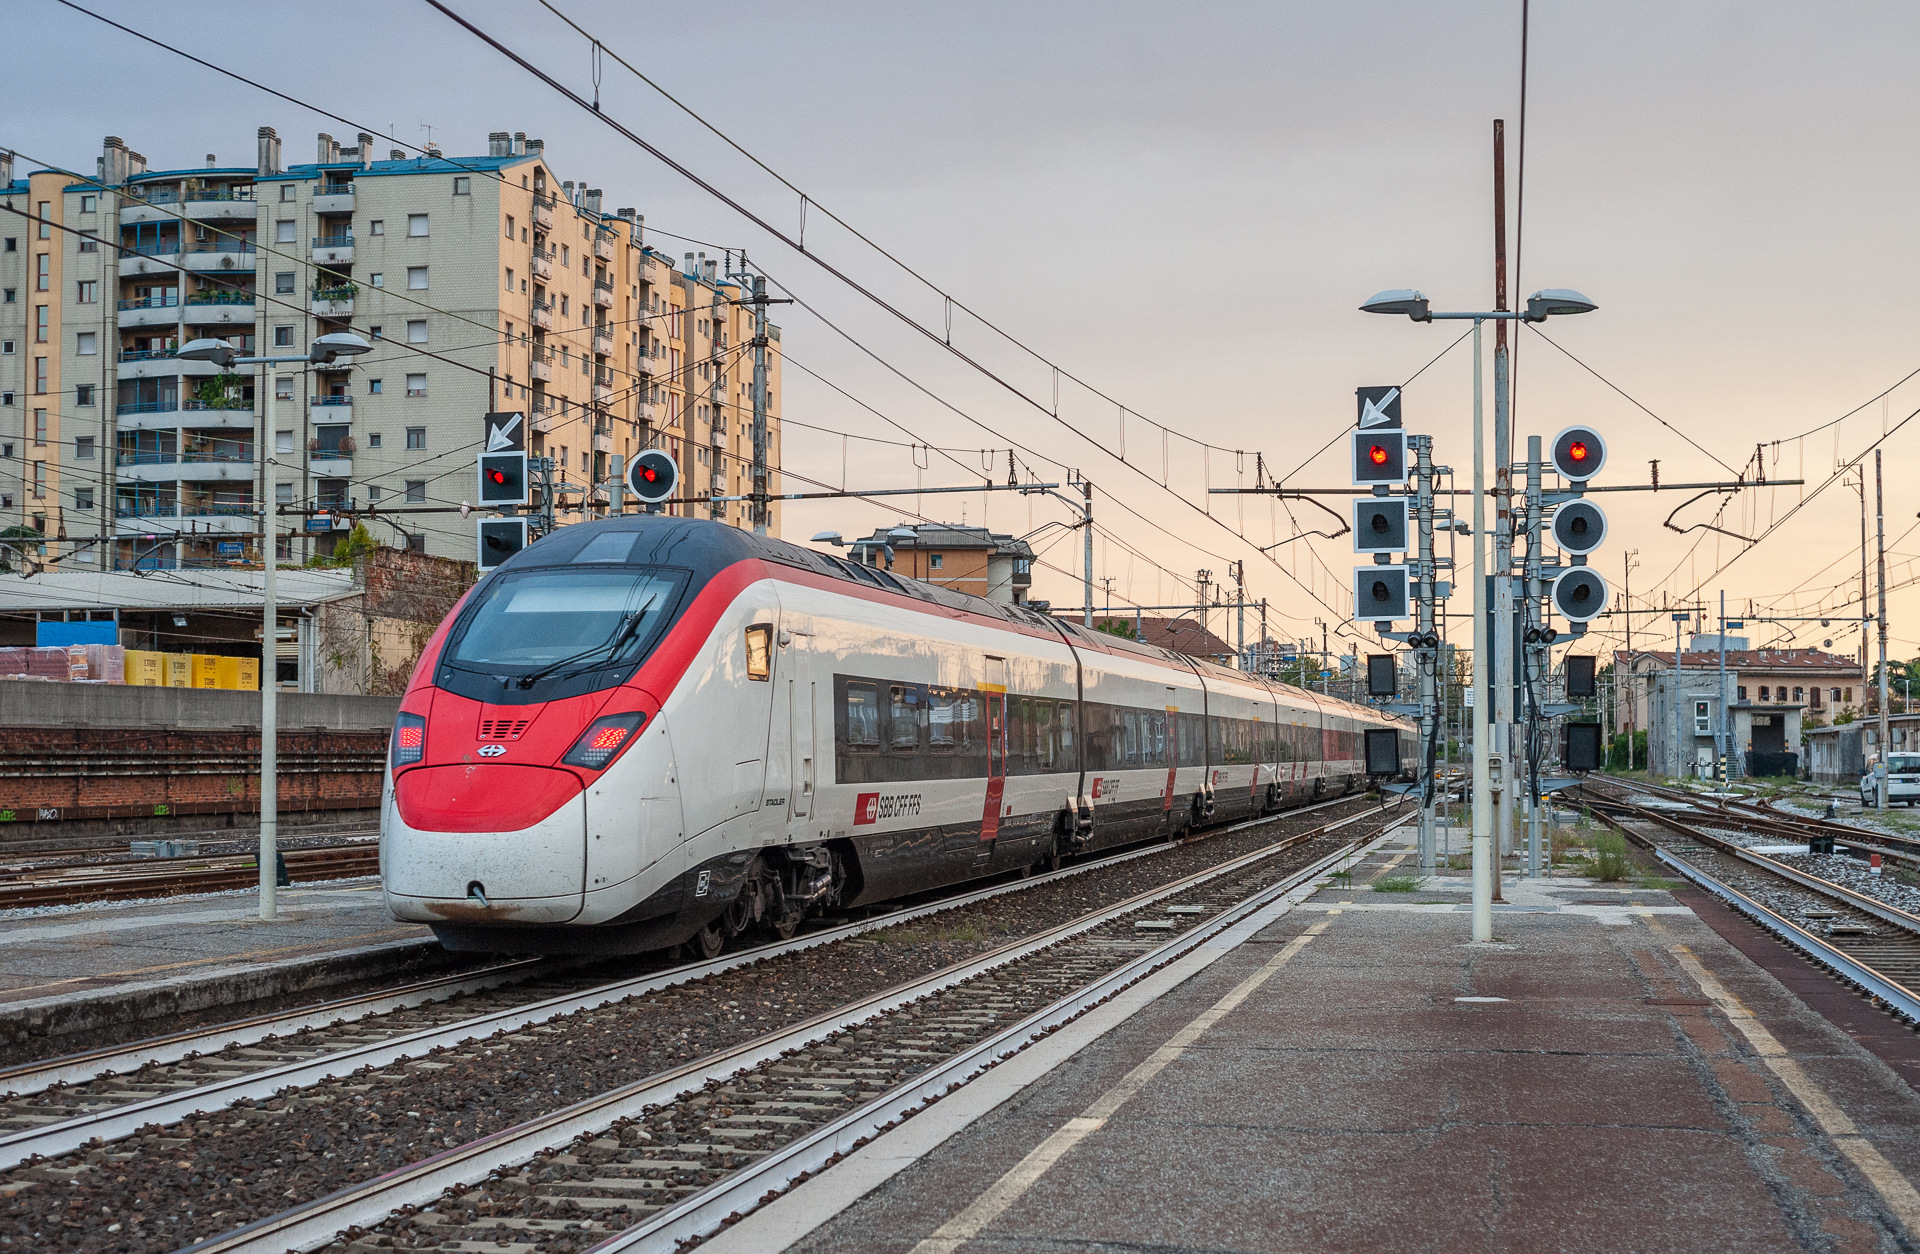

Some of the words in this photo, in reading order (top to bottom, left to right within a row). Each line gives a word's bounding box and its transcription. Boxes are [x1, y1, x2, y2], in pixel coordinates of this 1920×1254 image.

[766, 798, 785, 806] STADLER
[879, 796, 894, 819] SBB
[894, 795, 909, 817] CFF
[907, 794, 921, 816] FFS
